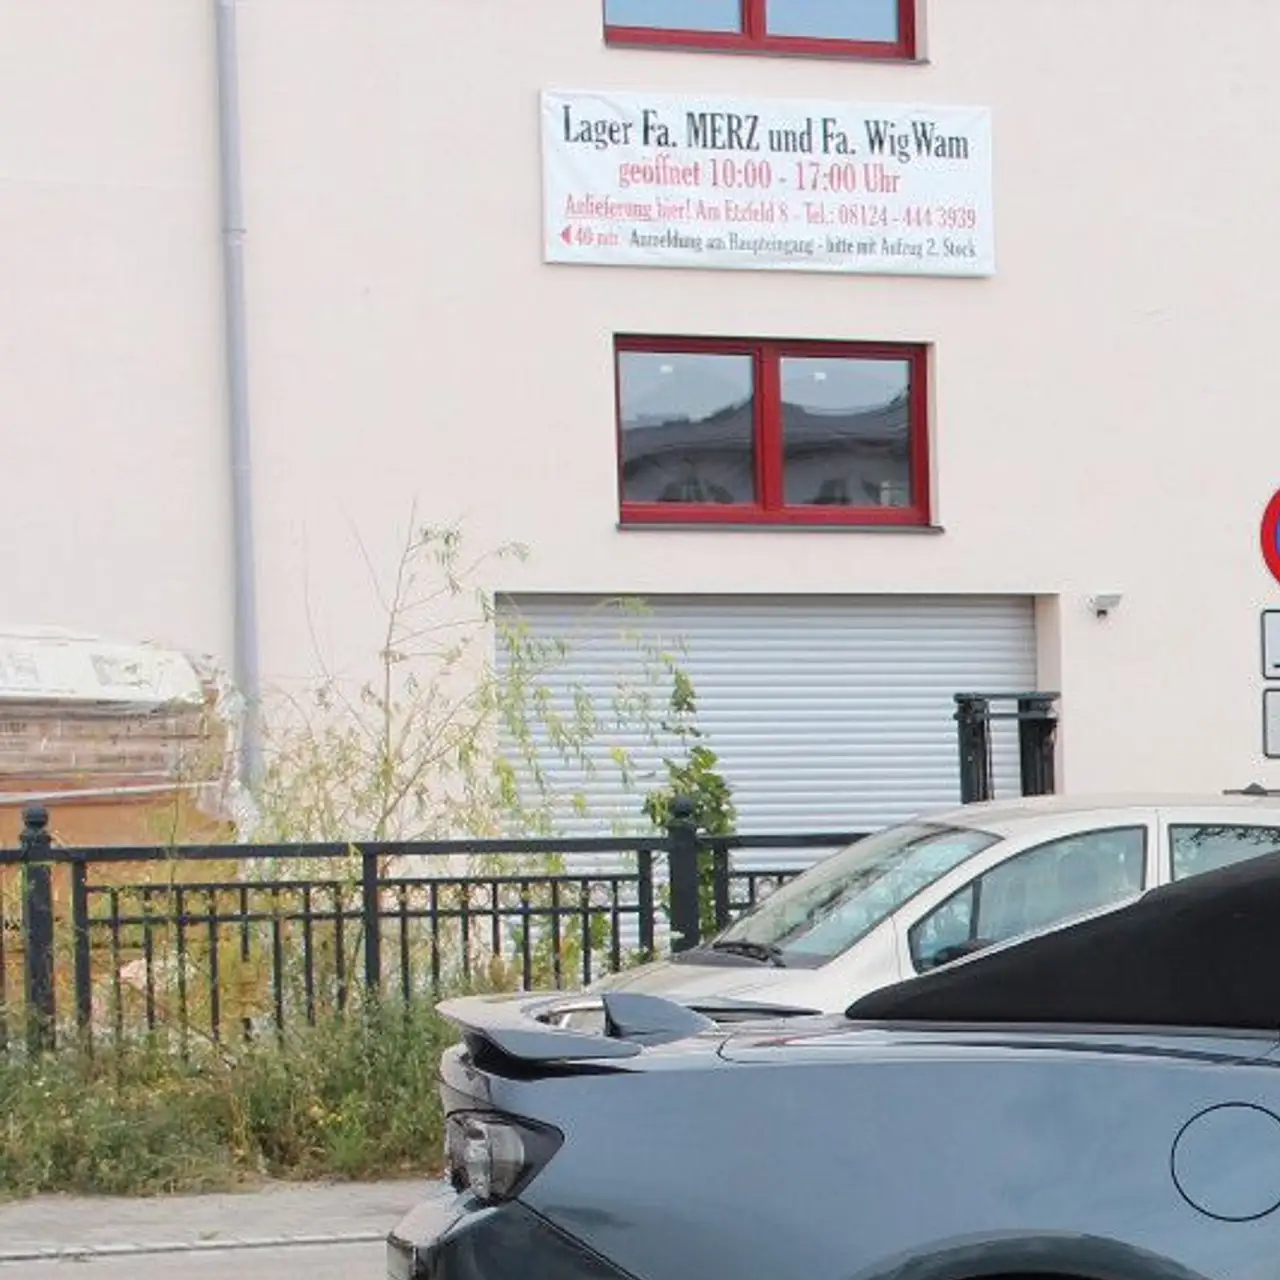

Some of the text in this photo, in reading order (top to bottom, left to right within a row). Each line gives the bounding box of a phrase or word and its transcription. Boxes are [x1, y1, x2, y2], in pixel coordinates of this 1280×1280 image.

[563, 105, 632, 149] Lager
[643, 109, 678, 147] Fa.
[687, 111, 760, 150] MERZ
[769, 117, 812, 153] und
[821, 118, 856, 155] Fa.
[711, 158, 771, 188] 10:00
[797, 162, 856, 192] 17:00
[863, 163, 900, 192] Uhr
[839, 204, 888, 226] 08124
[943, 237, 976, 258] Stock
